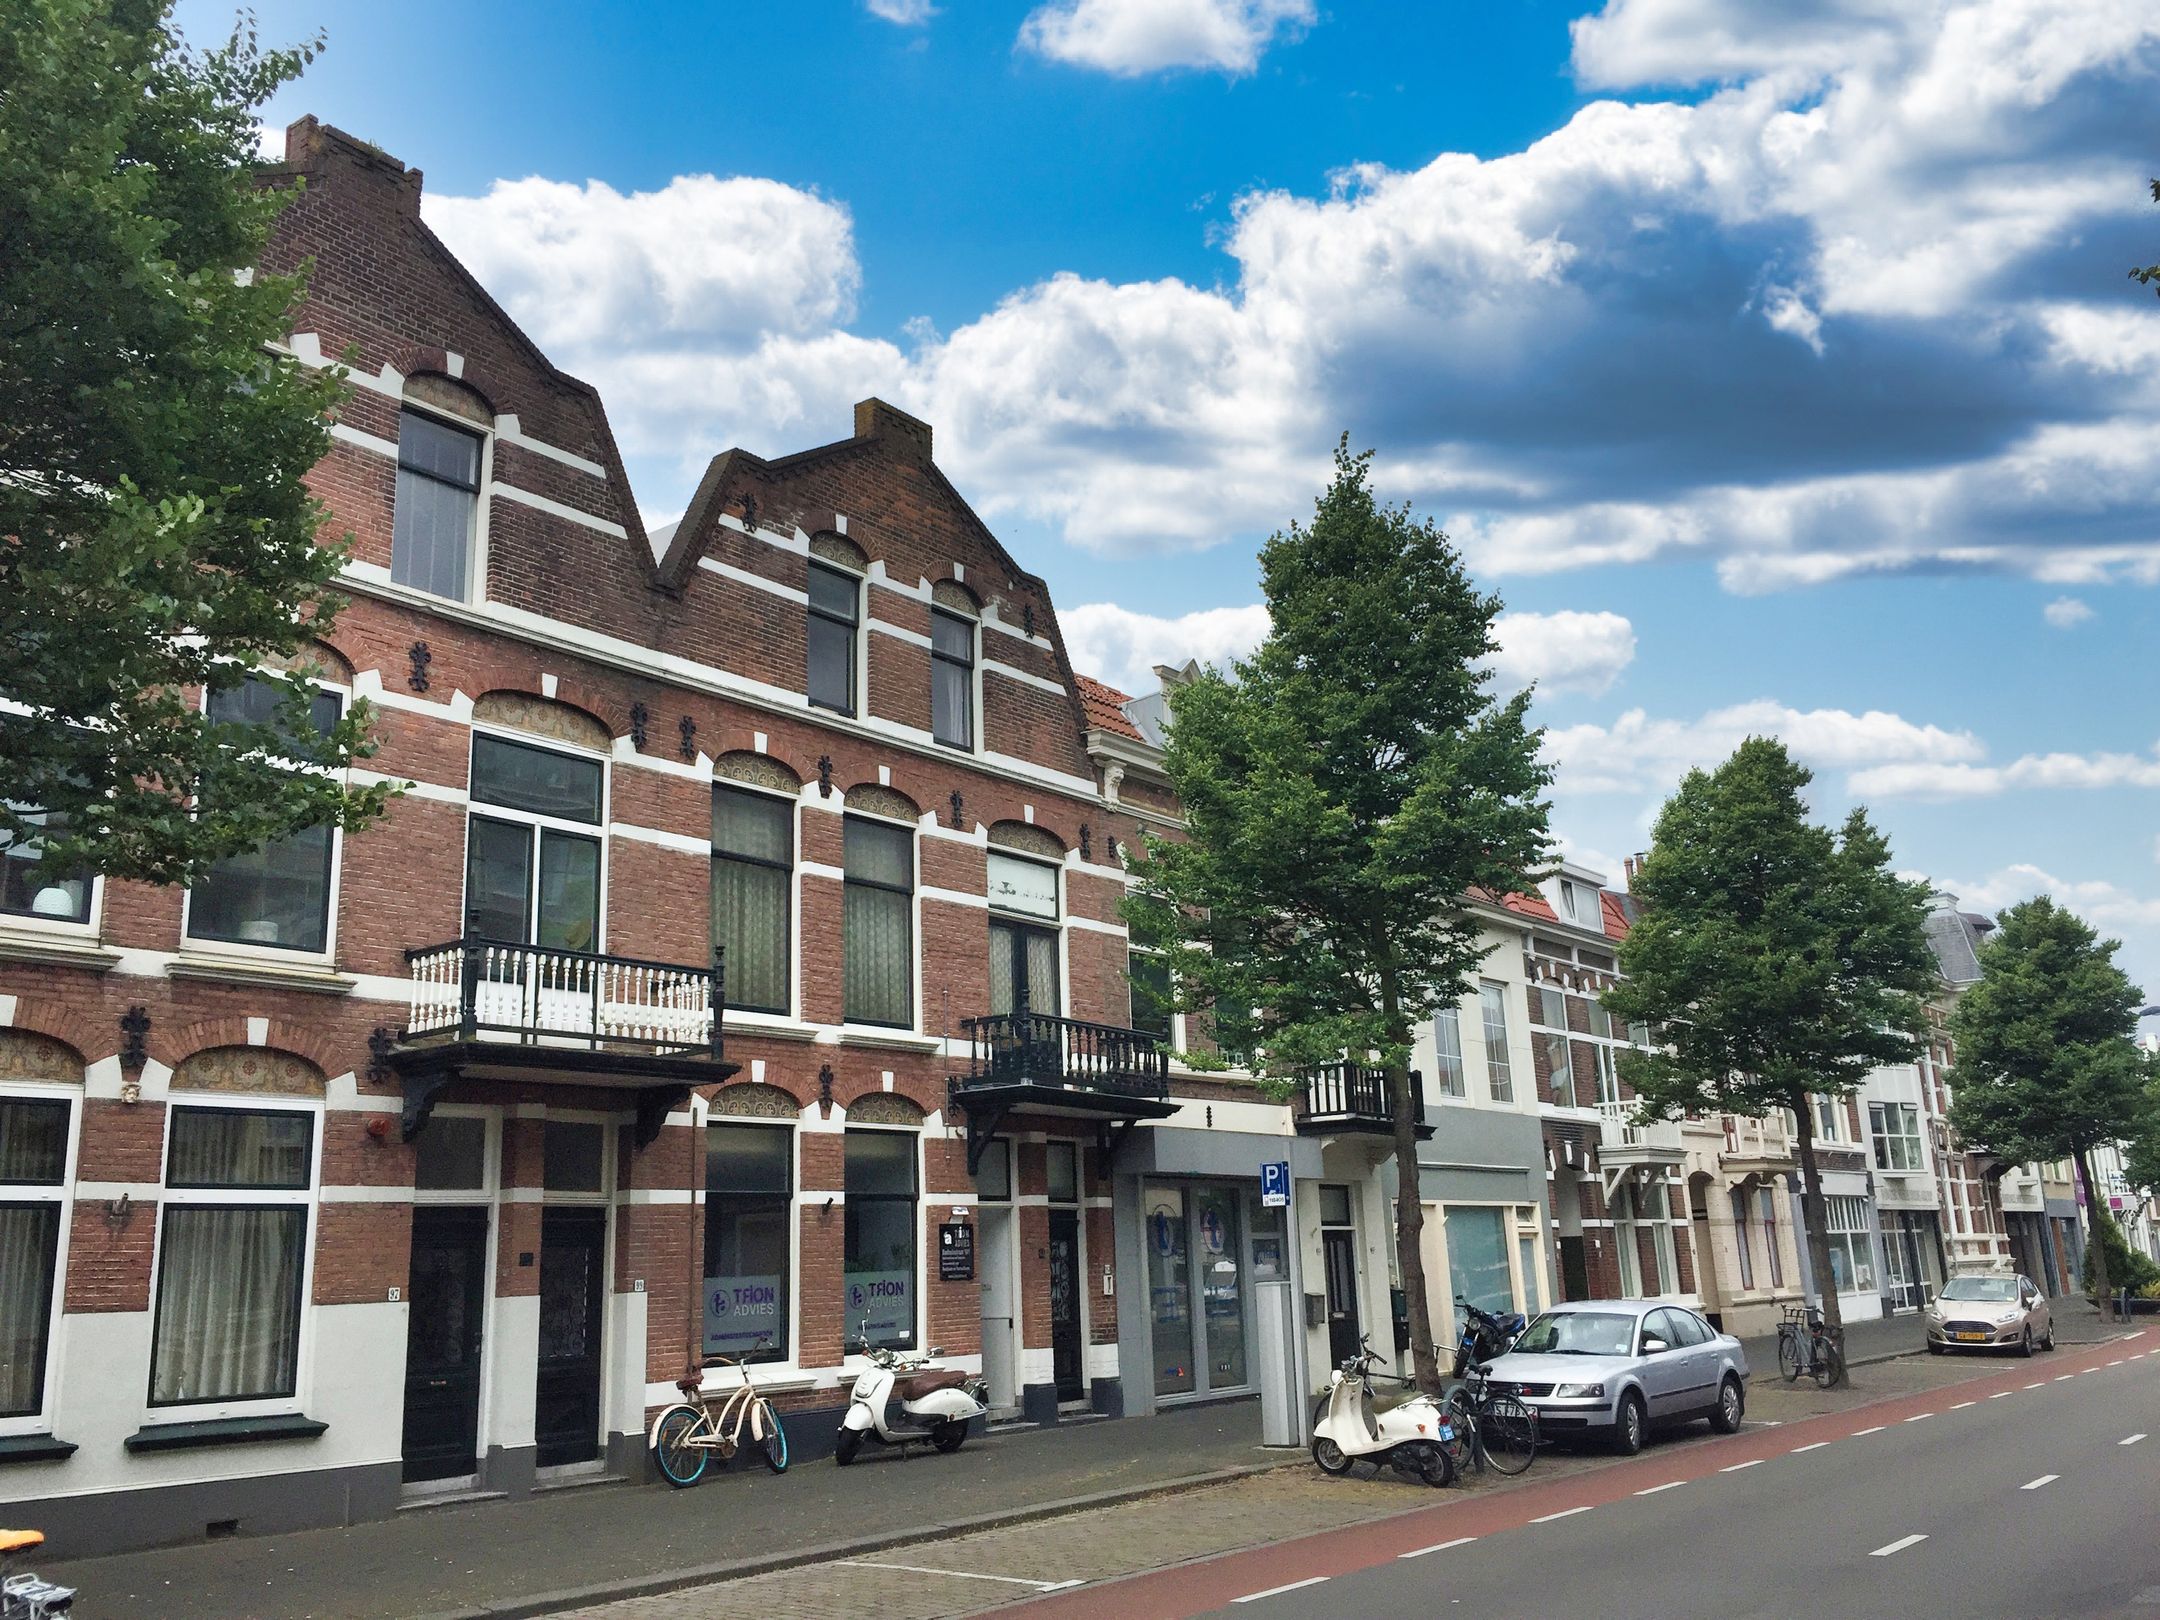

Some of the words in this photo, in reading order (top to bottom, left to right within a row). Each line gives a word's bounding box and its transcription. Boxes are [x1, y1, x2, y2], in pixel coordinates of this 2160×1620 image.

[1265, 1165, 1279, 1188] P
[389, 1288, 400, 1300] 97
[733, 1302, 775, 1317] ADVIES
